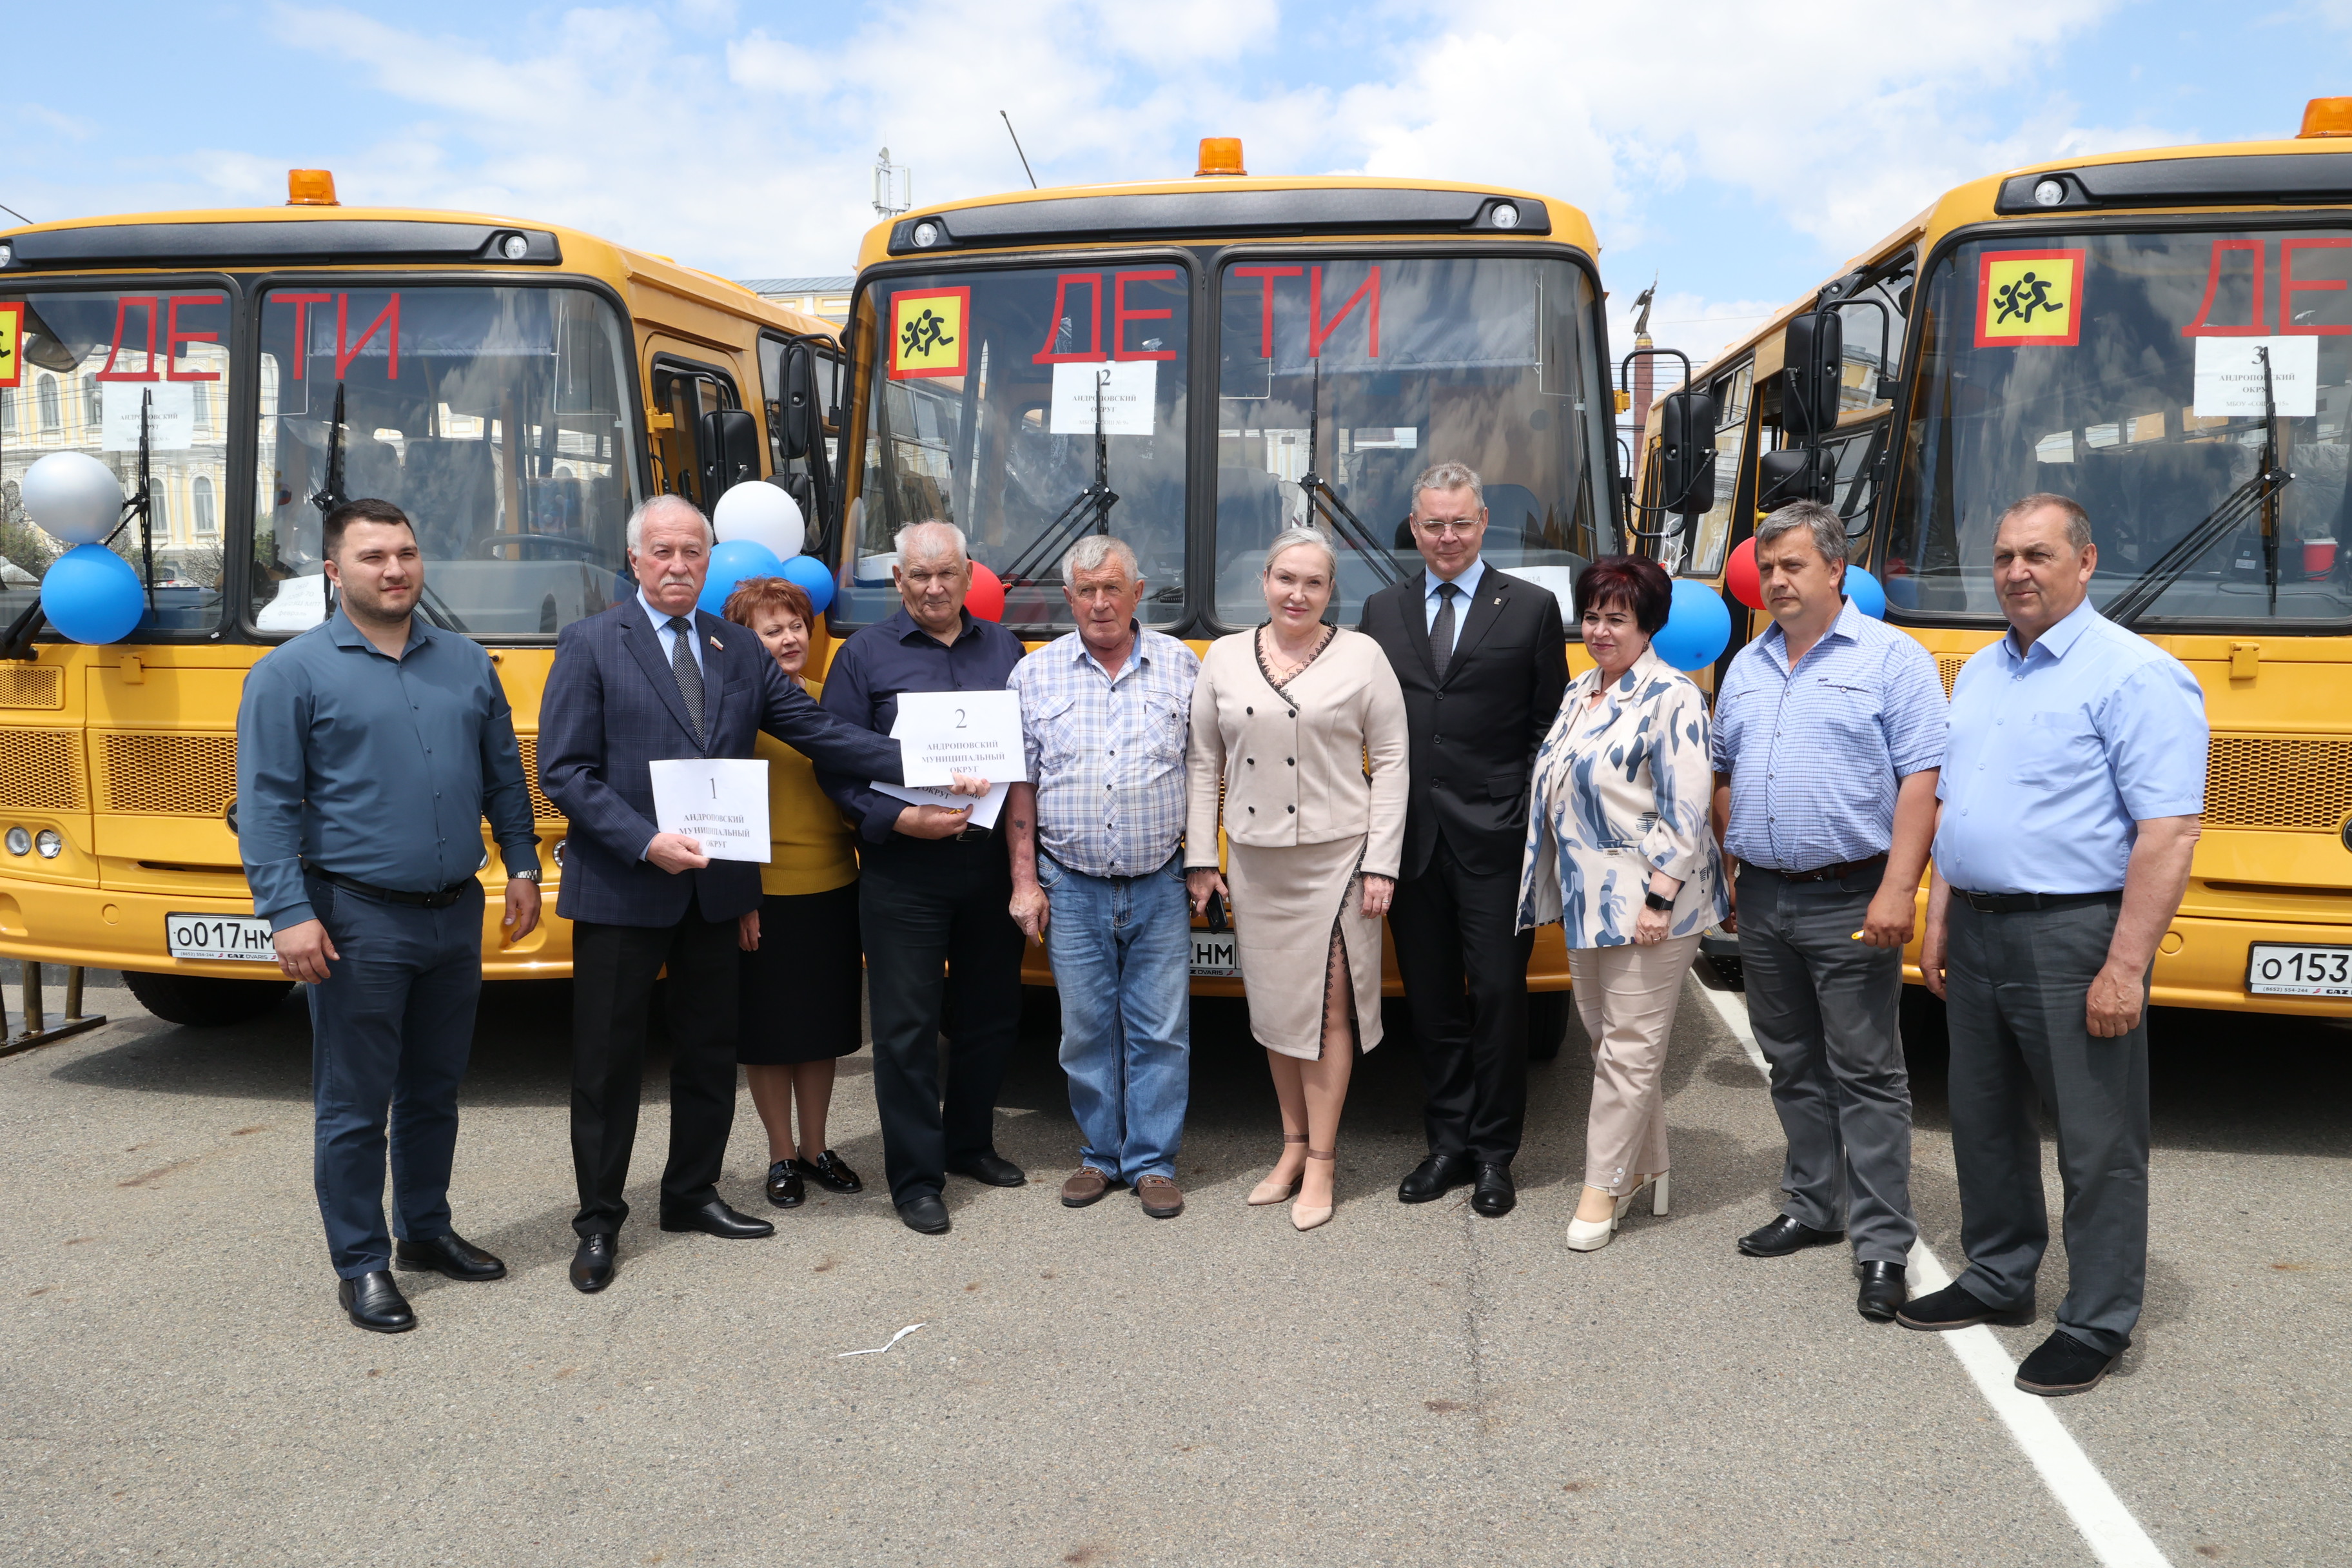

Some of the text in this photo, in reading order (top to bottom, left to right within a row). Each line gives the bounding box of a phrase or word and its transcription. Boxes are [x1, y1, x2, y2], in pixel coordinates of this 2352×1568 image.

[2181, 237, 2352, 337] ДЕ
[2251, 346, 2265, 364] 3
[1100, 369, 1112, 386] 2
[2219, 373, 2295, 382] АНДРОПОСКИЙ
[954, 709, 967, 729] 2
[926, 740, 999, 751] АНДРОПОВСКИЙ
[921, 752, 1005, 763] МУНИЦИПАЛЬНЫЙ
[950, 765, 979, 774] ОКРУГ
[709, 778, 717, 799] 1
[921, 786, 952, 799] ОКРУГ
[683, 813, 744, 823] АНДРОПОВСКИЙ
[679, 827, 750, 838] МУНИЦИПАЛЬНЫЙ
[706, 839, 727, 848] ОКРУГ
